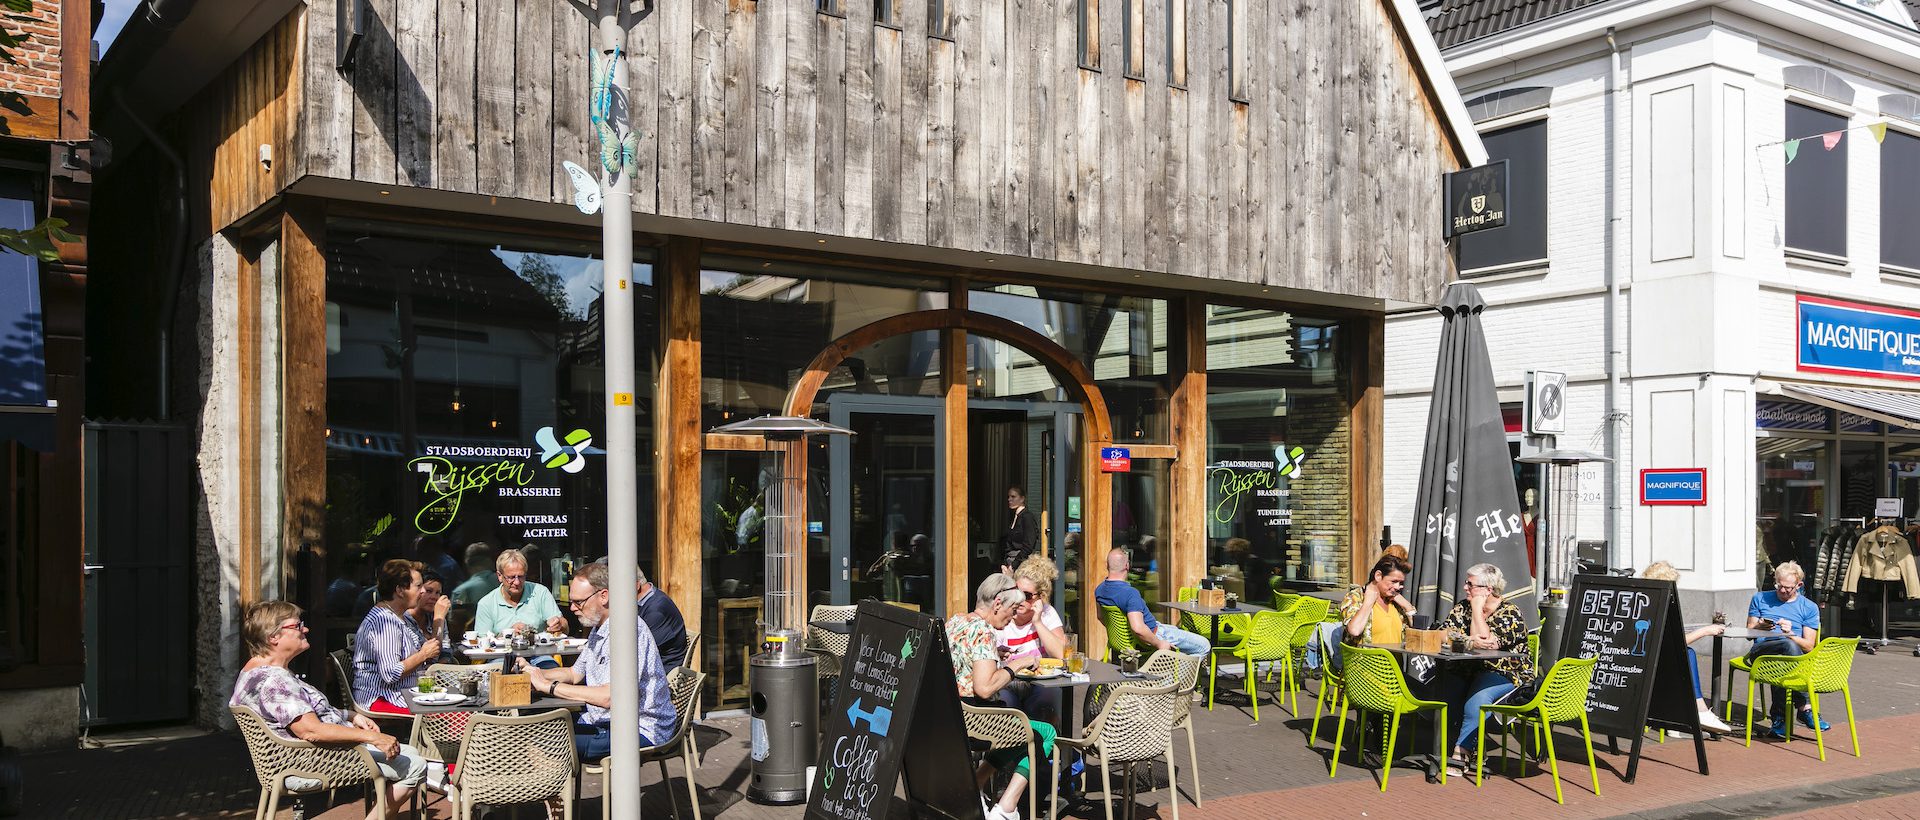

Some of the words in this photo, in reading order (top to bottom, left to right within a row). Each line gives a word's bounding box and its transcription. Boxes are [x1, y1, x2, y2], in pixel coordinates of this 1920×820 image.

[1454, 214, 1485, 229] Hertog
[1485, 210, 1503, 222] Jan
[1807, 320, 1920, 357] MAGNIFIQUE
[1756, 408, 1801, 421] etaalbare
[426, 446, 531, 459] STADSBOERDERIJ
[1220, 460, 1274, 469] STADSBOERDERIJ
[1647, 481, 1701, 489] MAGNIFIQUE
[407, 456, 535, 534] Rijssen
[499, 488, 561, 497] BRASSERIE
[1211, 467, 1276, 523] Rijssen
[499, 515, 568, 524] TUINTERRAS
[523, 529, 568, 538] ACHTER
[833, 735, 878, 783] Coffee
